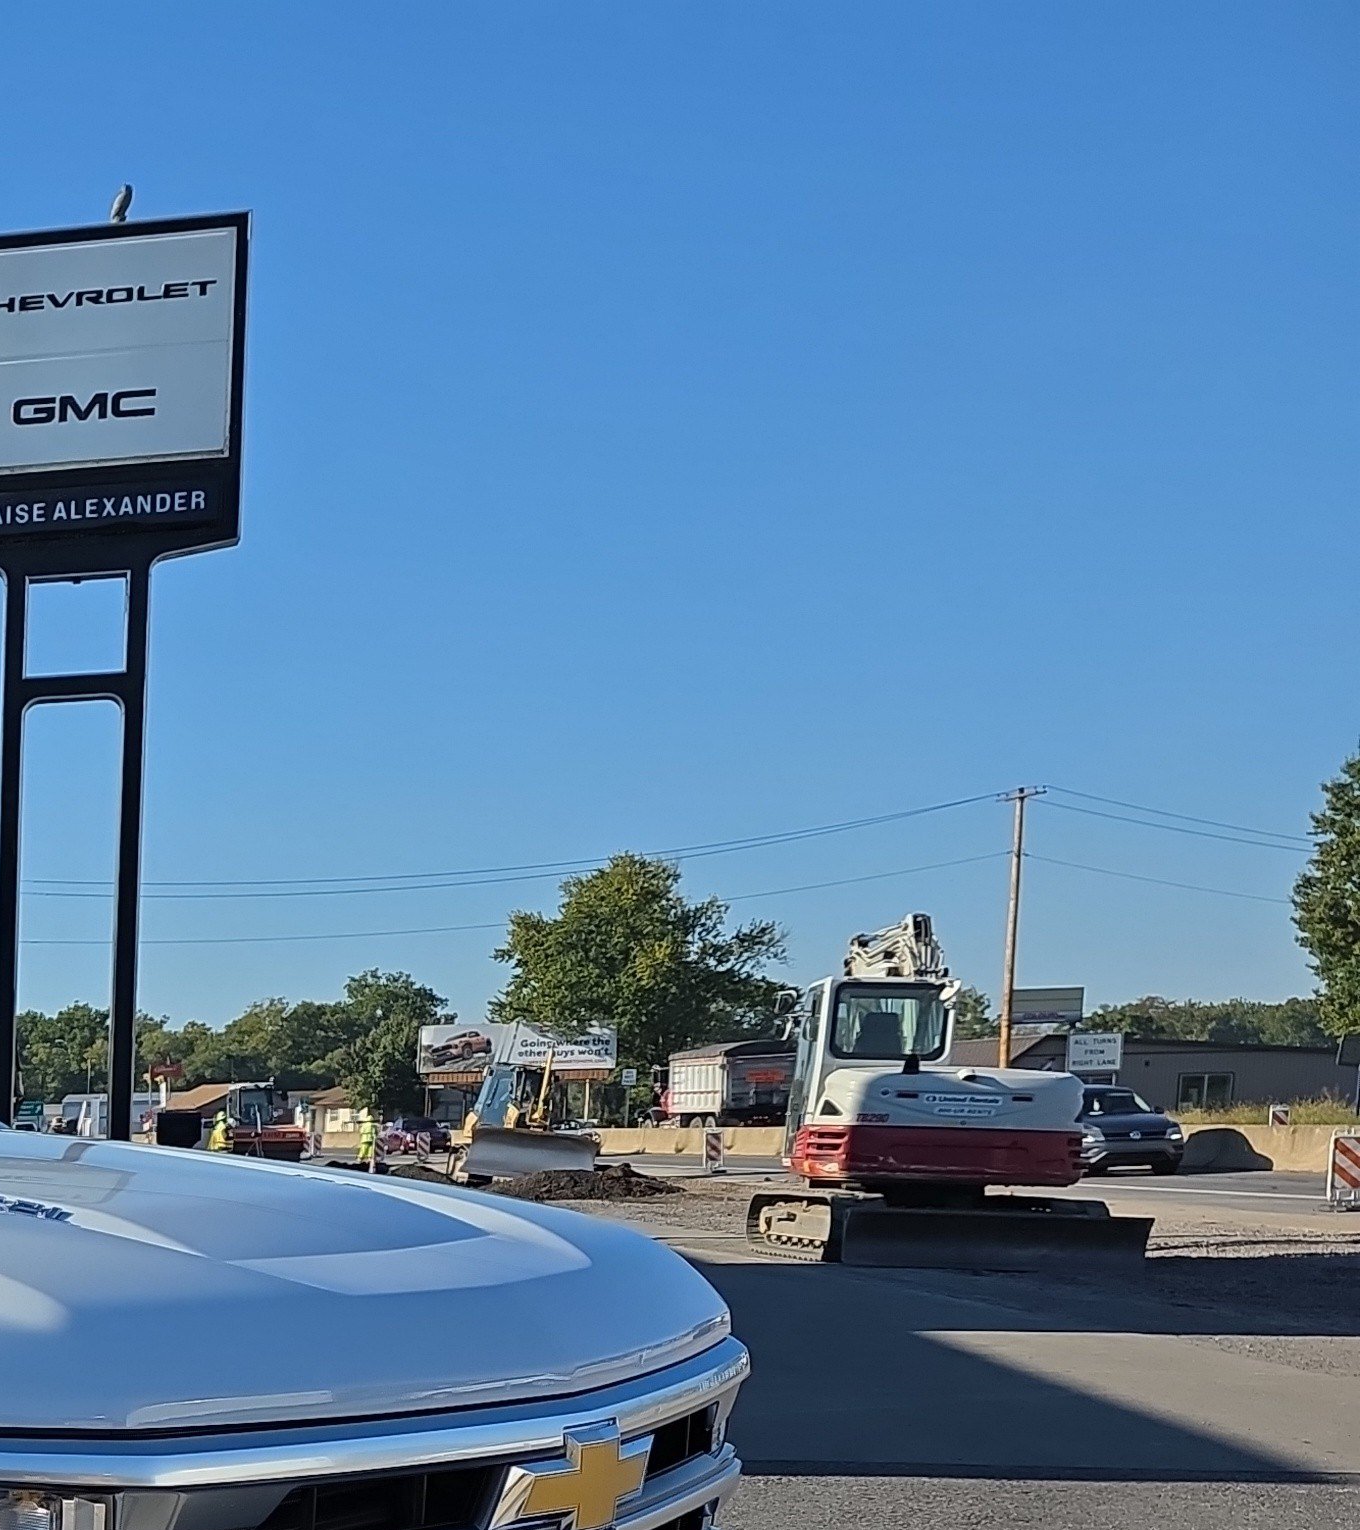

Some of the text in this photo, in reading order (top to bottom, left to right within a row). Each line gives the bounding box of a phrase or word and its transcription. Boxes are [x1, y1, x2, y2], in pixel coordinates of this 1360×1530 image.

[12, 388, 157, 426] GMC
[53, 490, 207, 521] ALEXANDER
[592, 1036, 611, 1046] the
[518, 1048, 547, 1057] other
